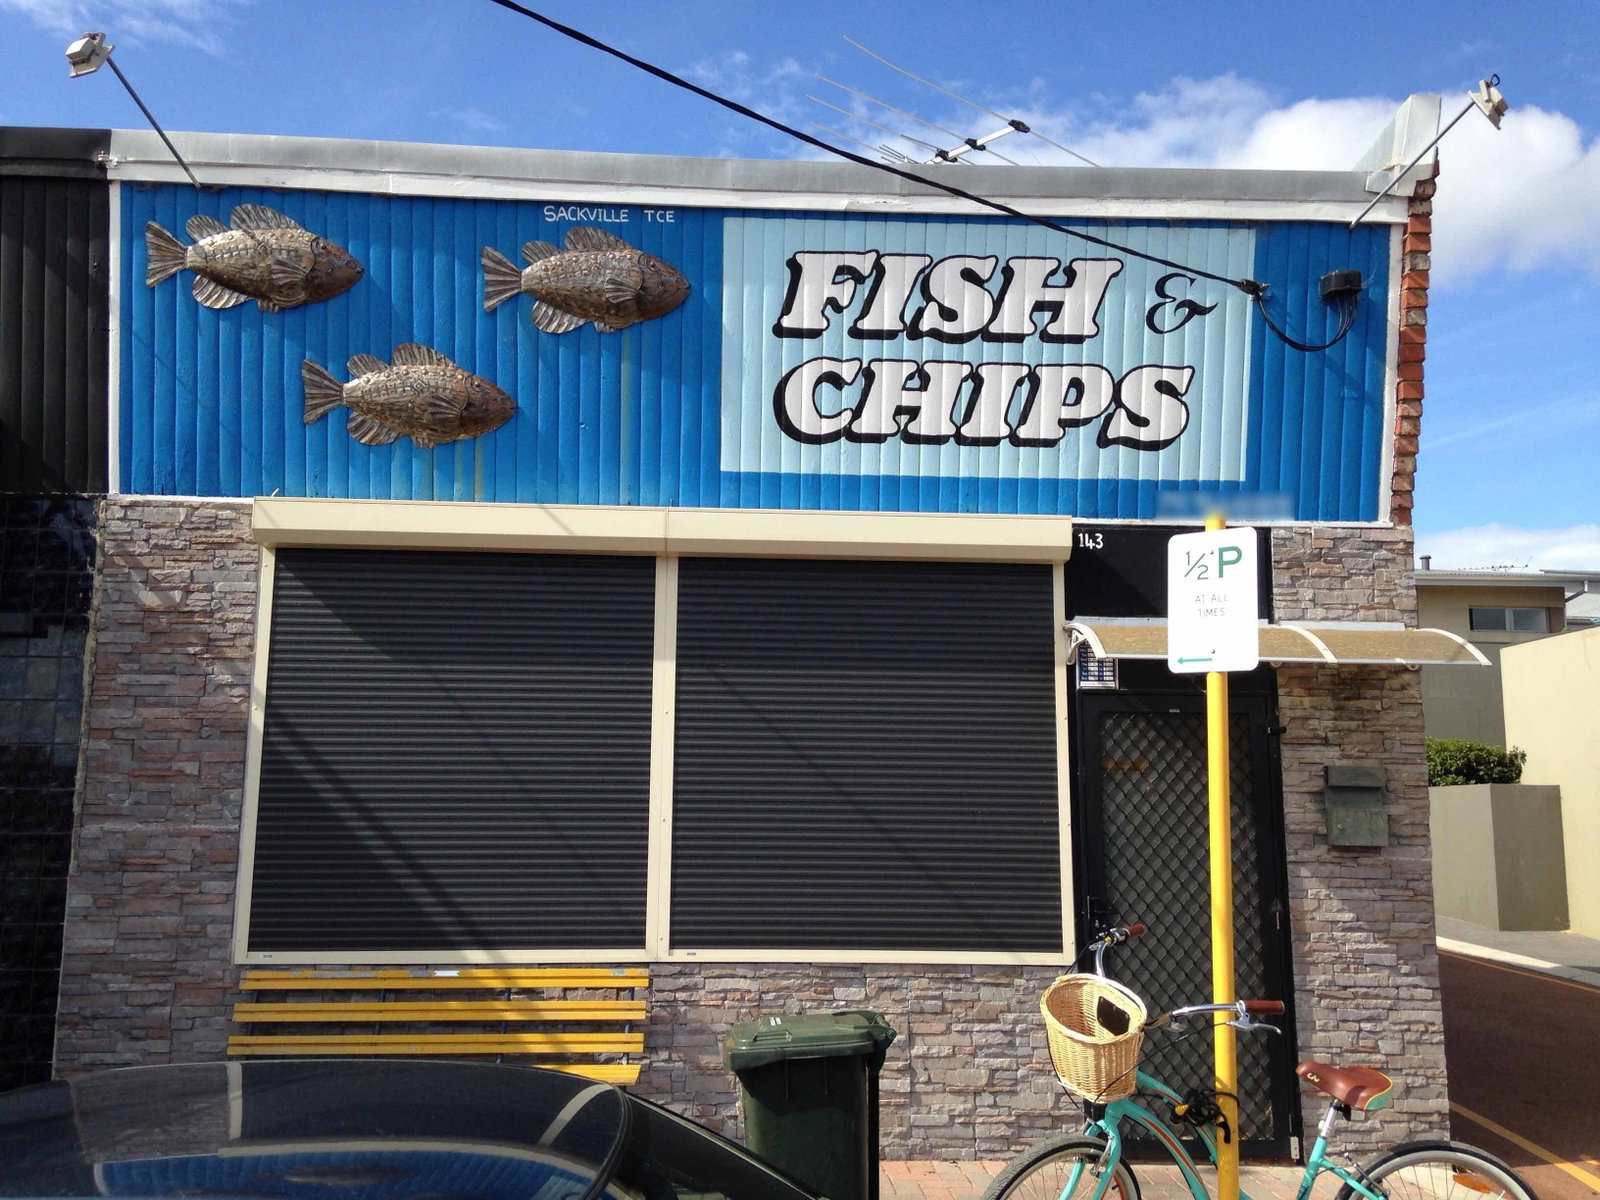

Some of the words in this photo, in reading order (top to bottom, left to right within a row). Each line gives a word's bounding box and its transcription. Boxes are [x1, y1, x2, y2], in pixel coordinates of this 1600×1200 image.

[543, 205, 629, 222] SACKVILLE
[643, 210, 675, 223] TCE
[773, 249, 1124, 343] FISH
[1146, 273, 1218, 334] &
[774, 357, 1195, 451] CHIPS
[1078, 533, 1104, 550] 143
[1195, 595, 1205, 604] AT
[1211, 594, 1229, 603] ALL
[1198, 607, 1226, 617] TIMES
